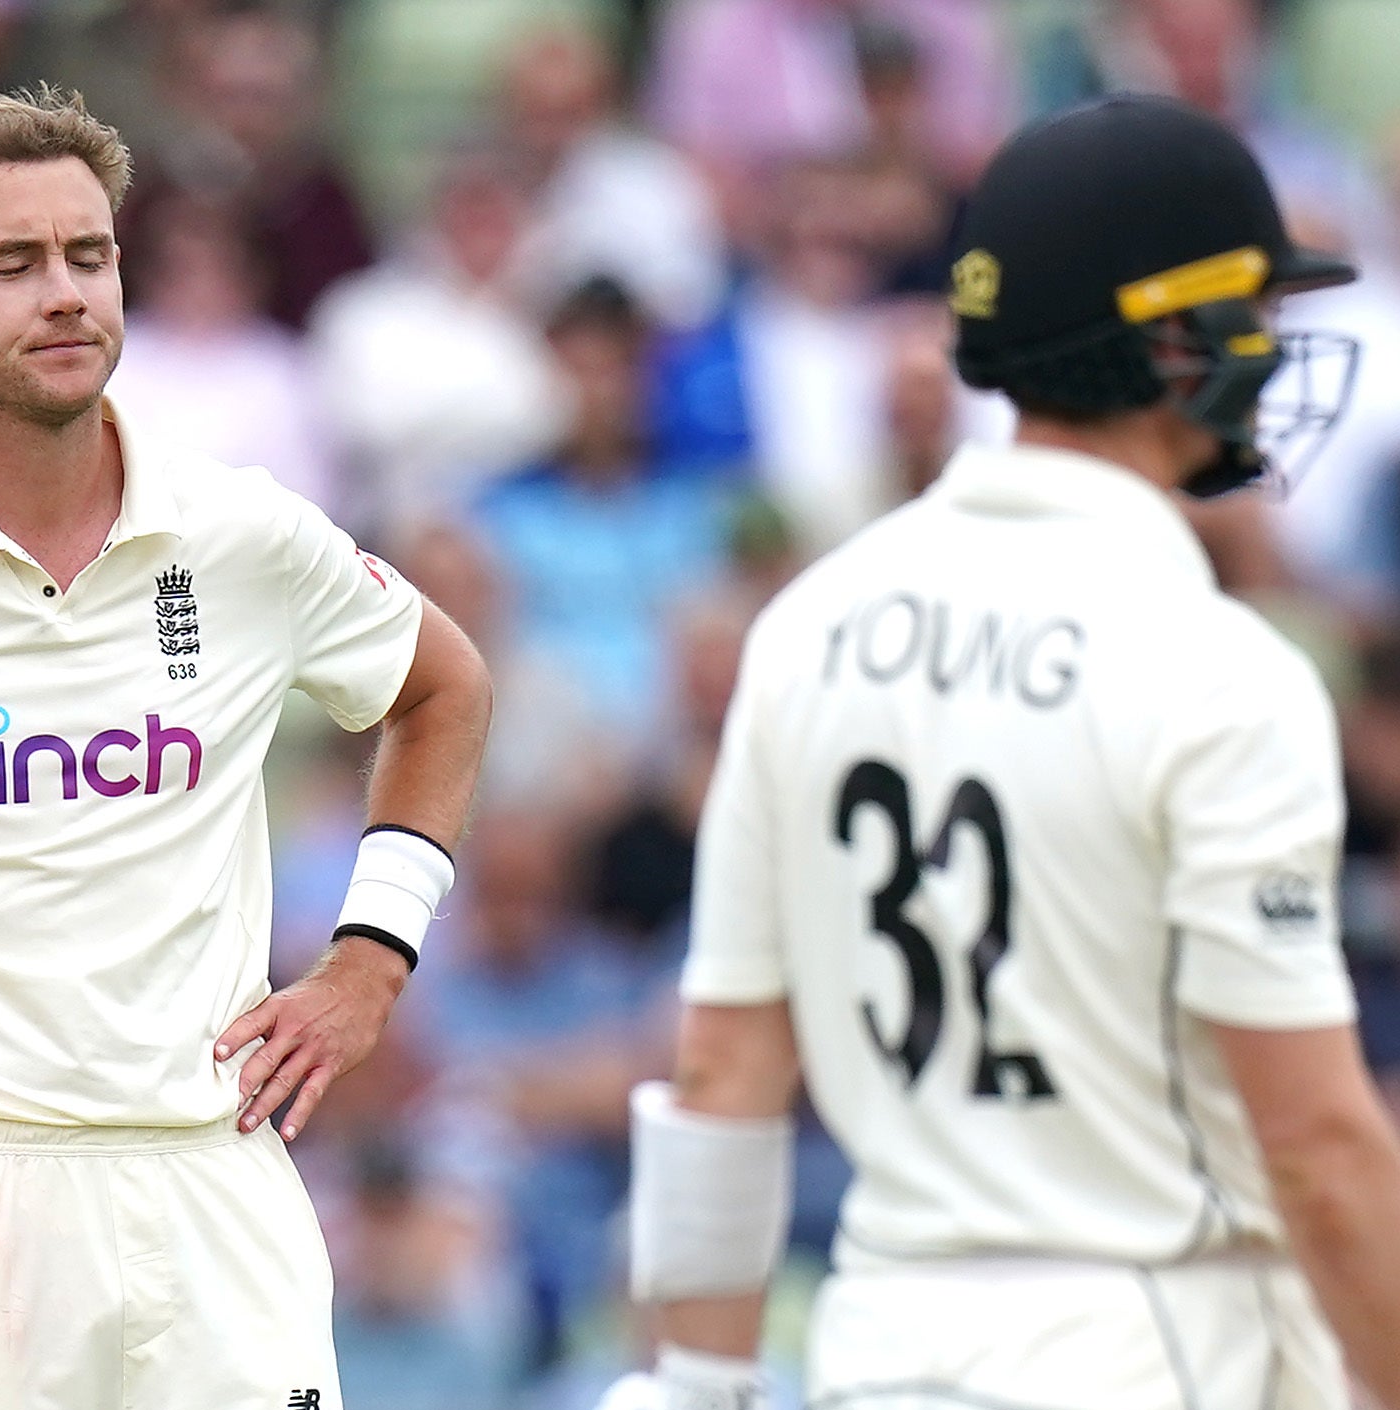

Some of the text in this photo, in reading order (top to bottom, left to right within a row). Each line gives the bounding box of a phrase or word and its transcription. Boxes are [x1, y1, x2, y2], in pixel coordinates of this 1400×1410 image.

[168, 663, 197, 680] 638
[819, 589, 1088, 713] YOUNG
[833, 755, 1057, 1096] 32
